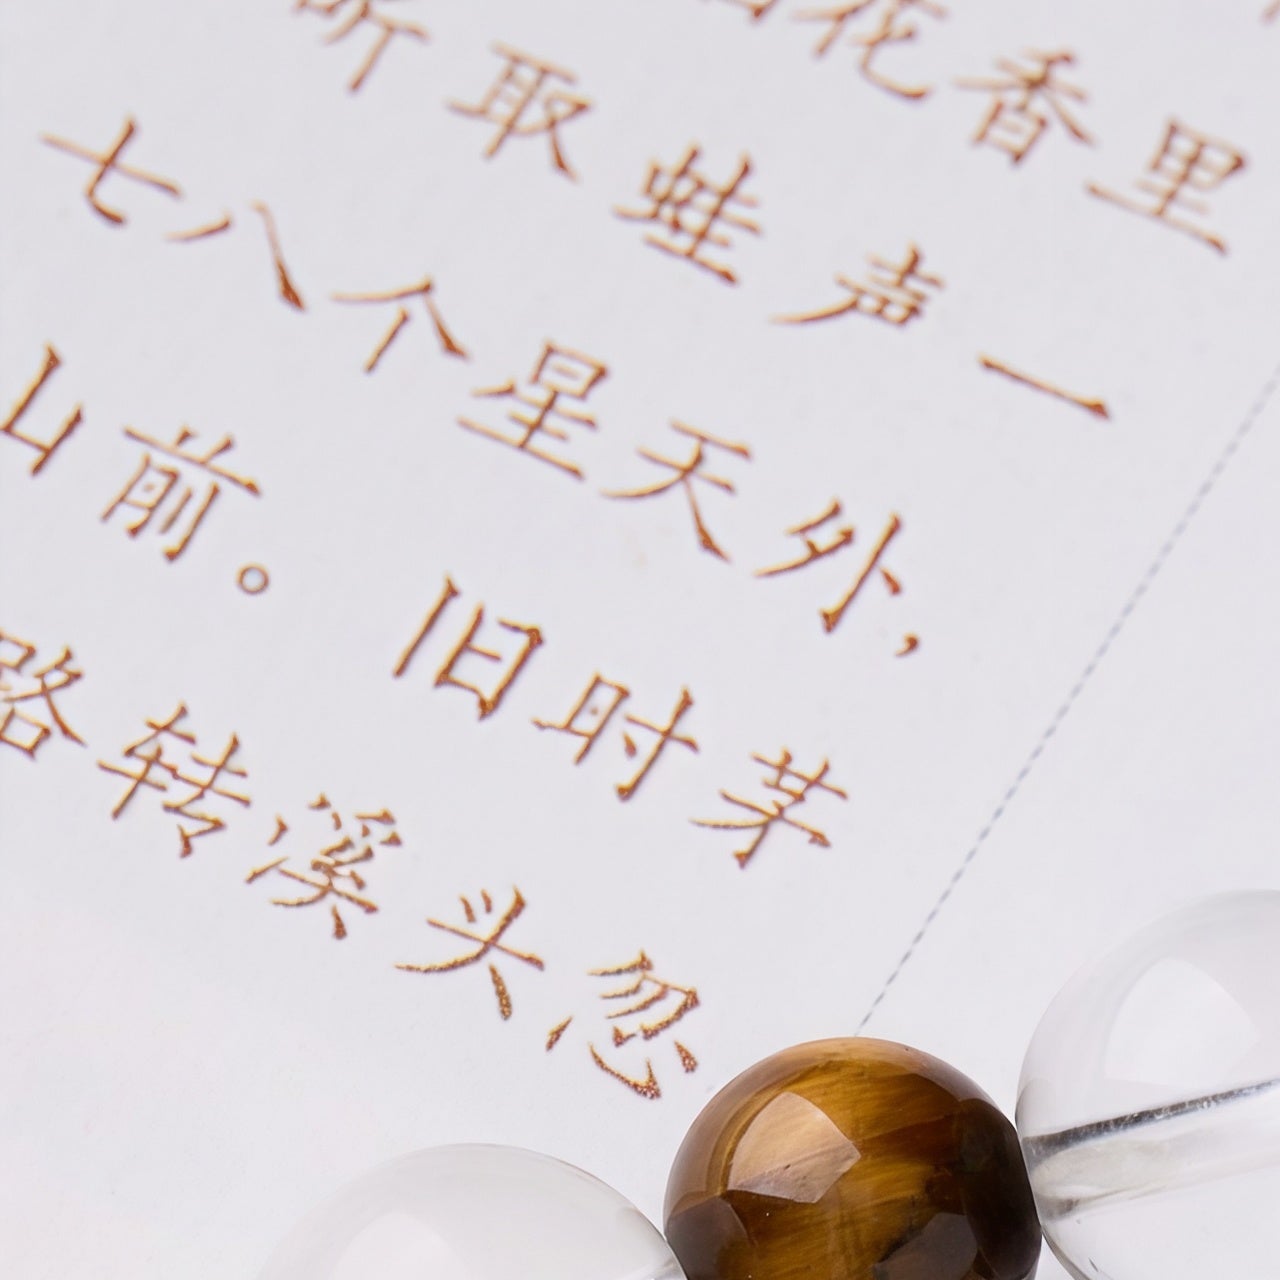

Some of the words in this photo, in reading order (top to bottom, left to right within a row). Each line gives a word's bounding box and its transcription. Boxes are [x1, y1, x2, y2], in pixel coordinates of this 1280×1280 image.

[734, 0, 1249, 258] 花香里
[0, 624, 702, 1102] 路转溪头忽
